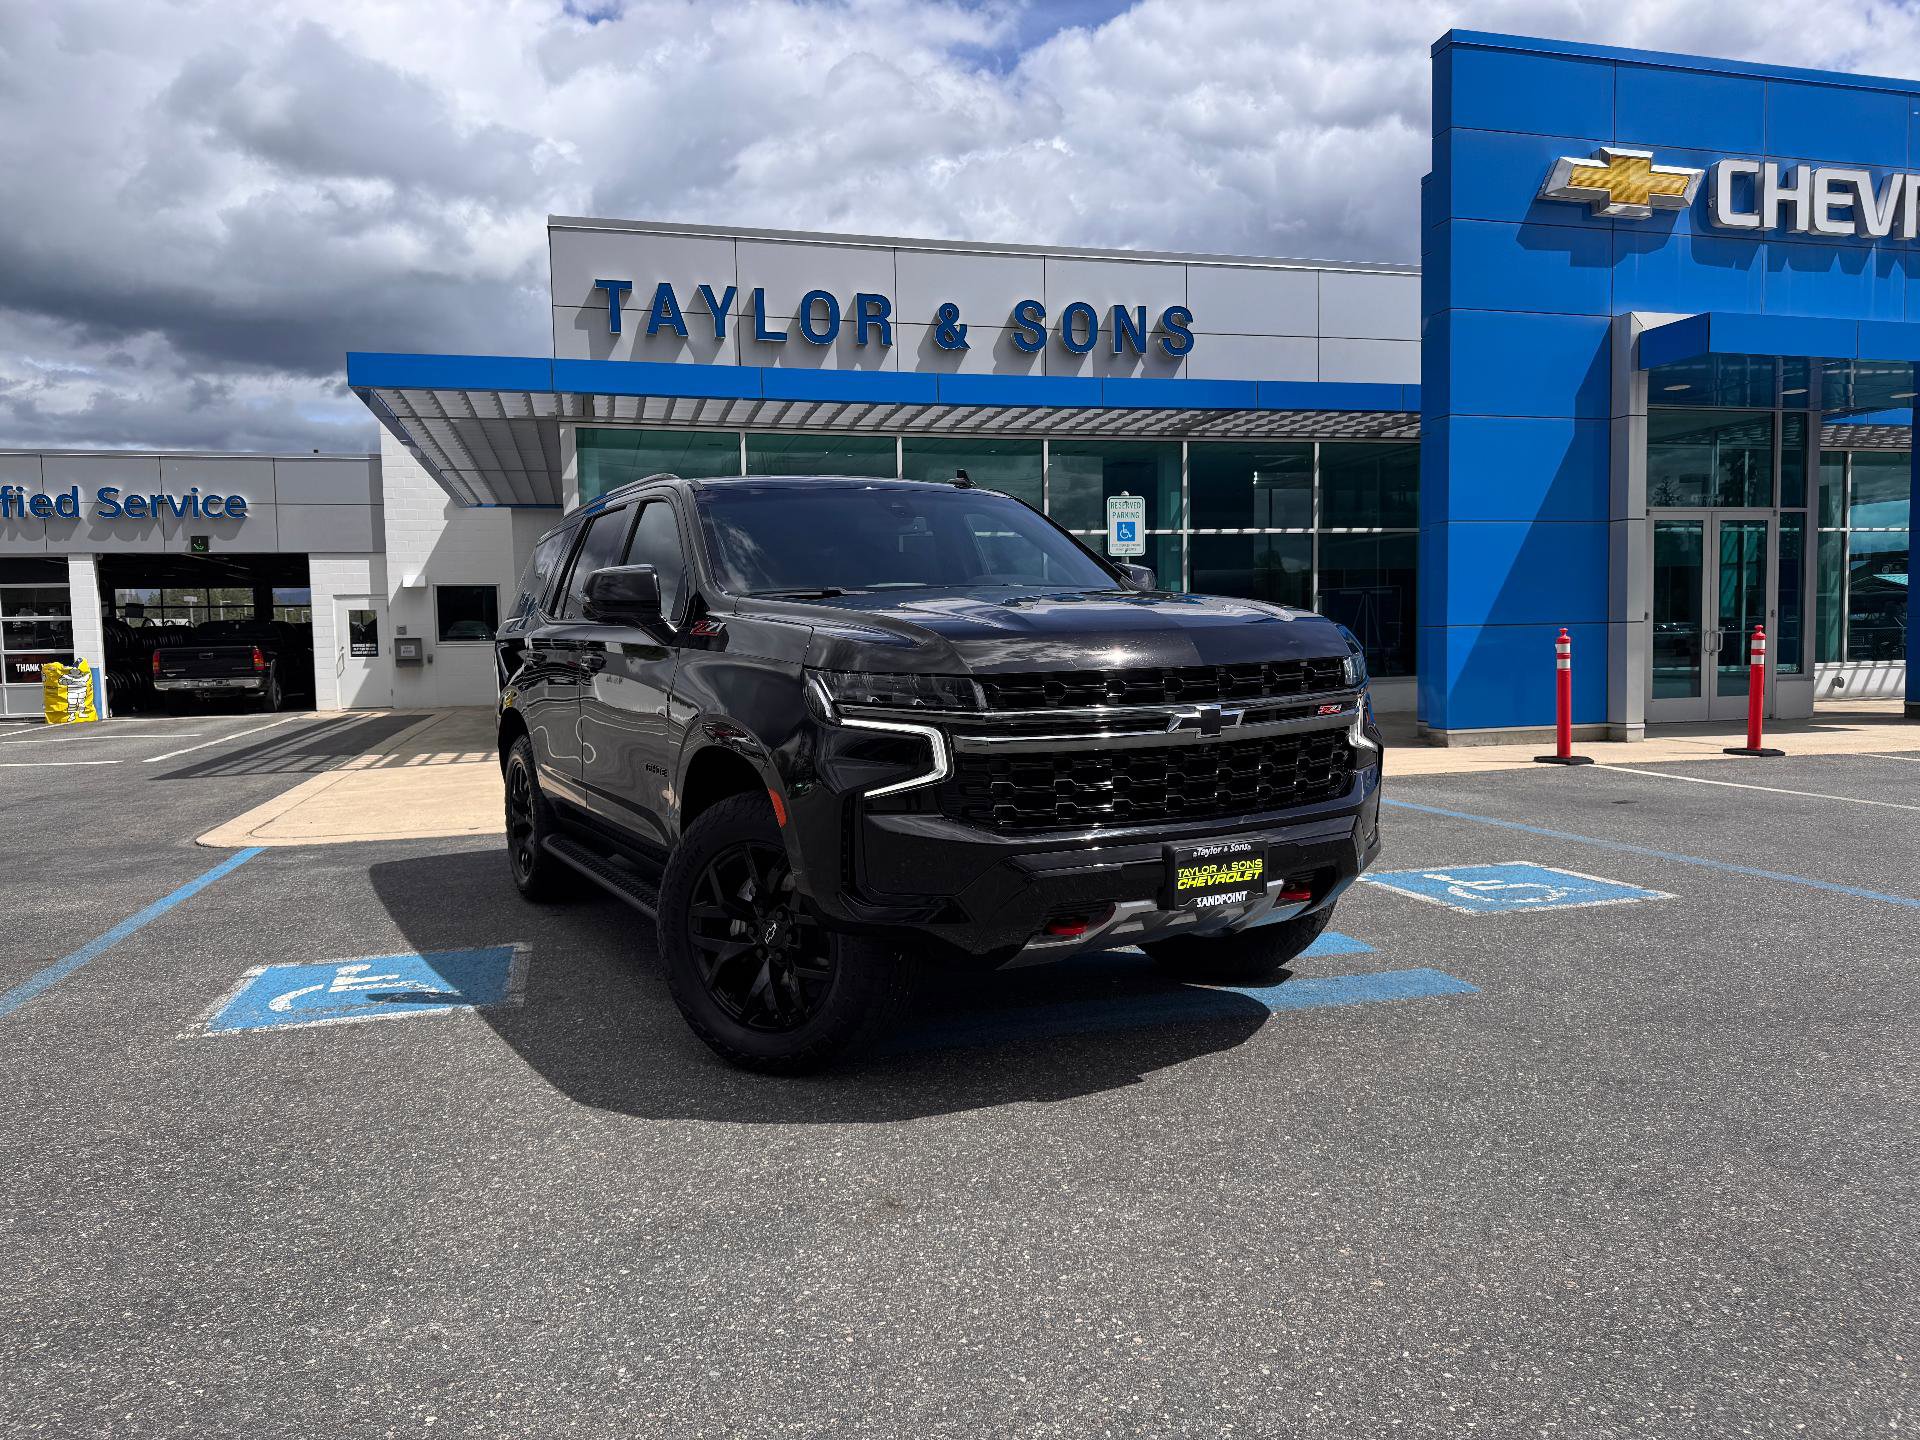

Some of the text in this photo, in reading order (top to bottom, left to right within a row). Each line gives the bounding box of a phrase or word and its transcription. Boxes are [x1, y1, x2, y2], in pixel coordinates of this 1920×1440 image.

[594, 278, 1195, 357] TAYLOR & SONS
[96, 486, 248, 519] Service
[1110, 501, 1142, 510] RESERVED
[1112, 511, 1140, 519] PARKING
[16, 663, 40, 673] THANK
[1197, 846, 1221, 857] Taylor
[1229, 843, 1247, 852] Sons
[1178, 858, 1263, 878] TAYLOR & SONS
[1177, 869, 1263, 890] CHEVROLET
[1196, 891, 1248, 908] SANDPOINT
